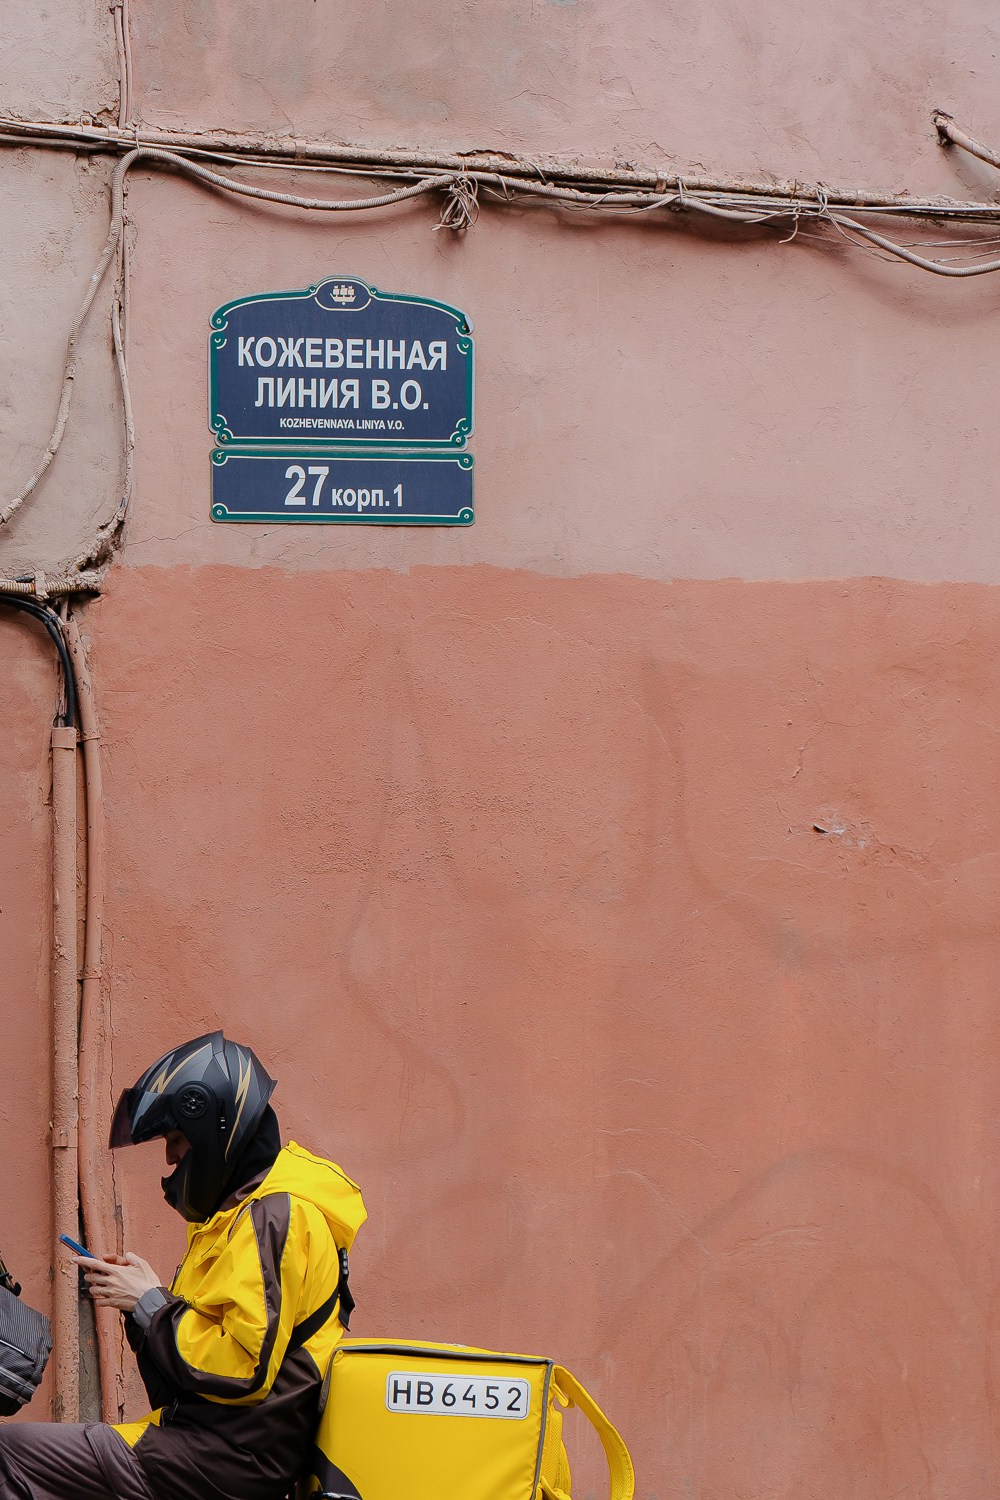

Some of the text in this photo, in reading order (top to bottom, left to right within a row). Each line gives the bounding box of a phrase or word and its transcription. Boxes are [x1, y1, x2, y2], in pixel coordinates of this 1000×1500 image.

[237, 336, 447, 371] КОЖЕВЕННАЯ
[254, 377, 430, 411] ЛИНИЯ В.О.
[279, 417, 405, 431] KOZHEVENNAYA LINIYA V.O.
[284, 465, 403, 512] 27 корп. 1
